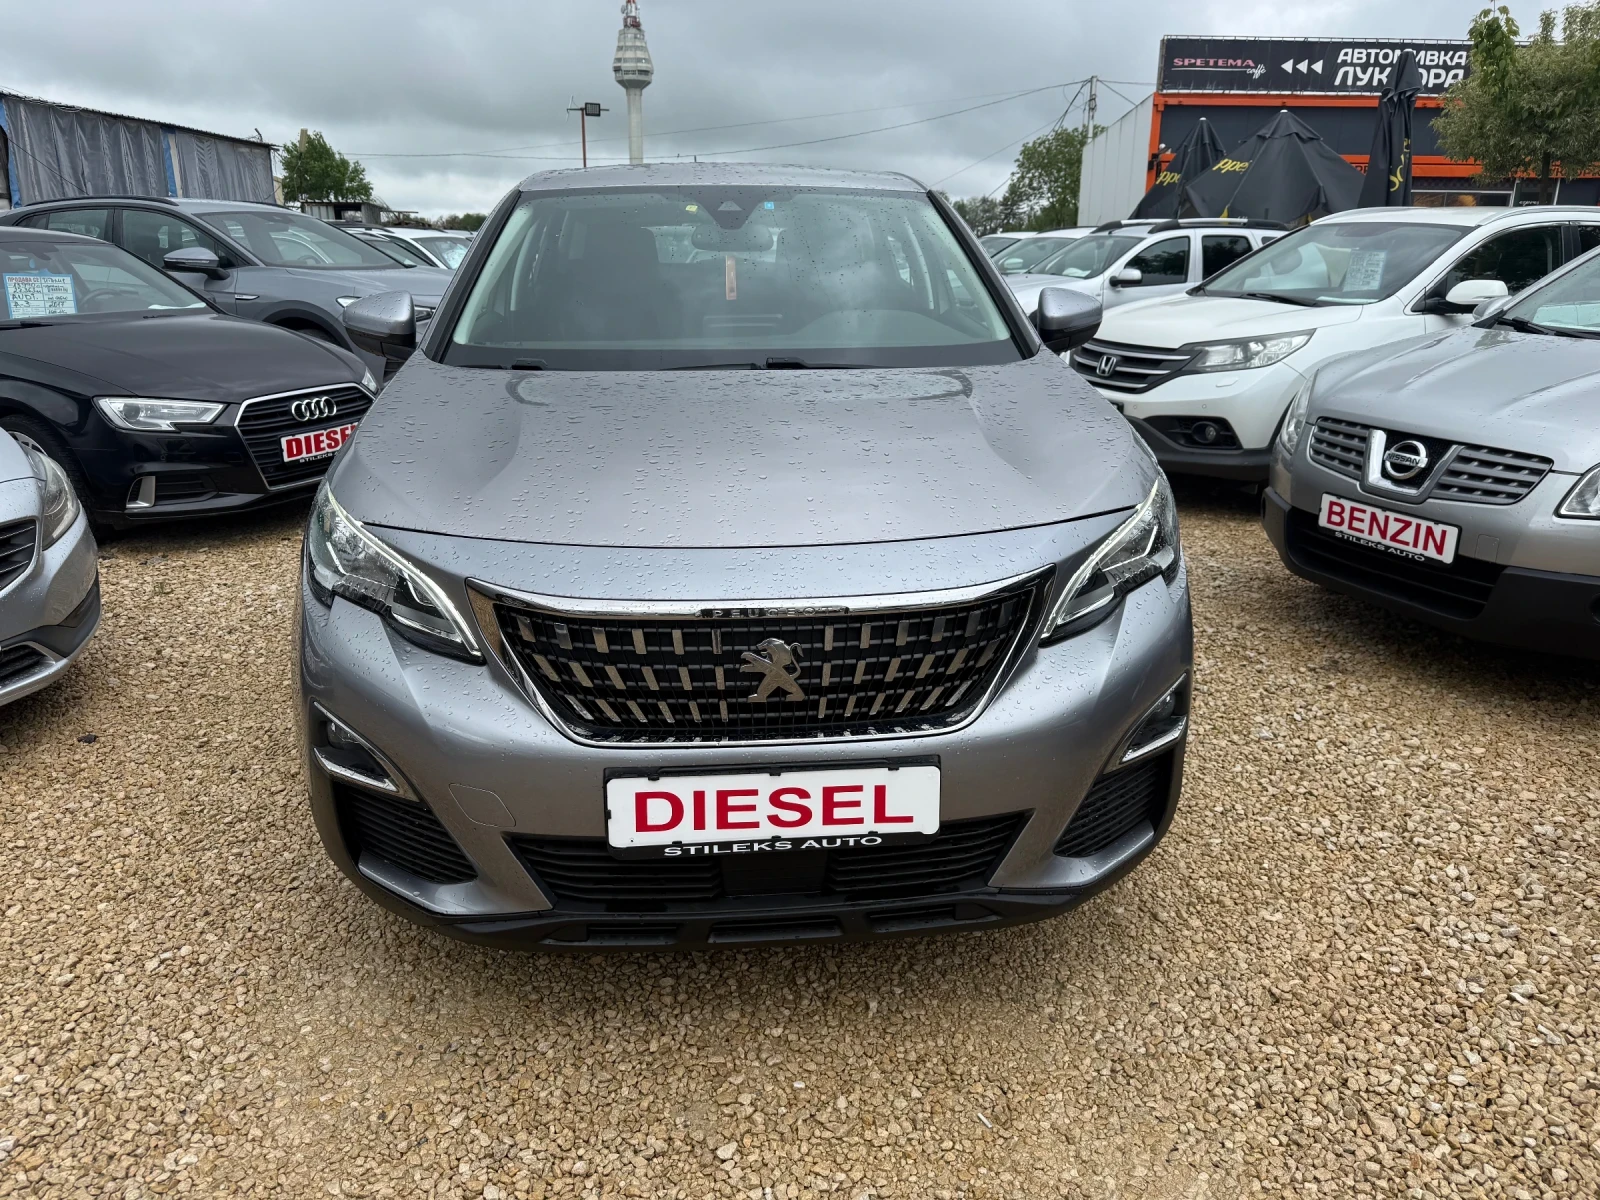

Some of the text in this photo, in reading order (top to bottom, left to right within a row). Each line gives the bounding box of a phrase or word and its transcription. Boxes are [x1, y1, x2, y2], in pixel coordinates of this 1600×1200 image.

[1173, 58, 1255, 67] SPETEMA
[1387, 452, 1421, 465] NISSAN
[1326, 500, 1447, 556] BENZIN
[1335, 531, 1425, 562] STILEKS AUTO
[712, 606, 834, 618] PEUGEOT
[635, 784, 914, 833] DIESEL
[664, 836, 882, 856] STILEKS AUTO
